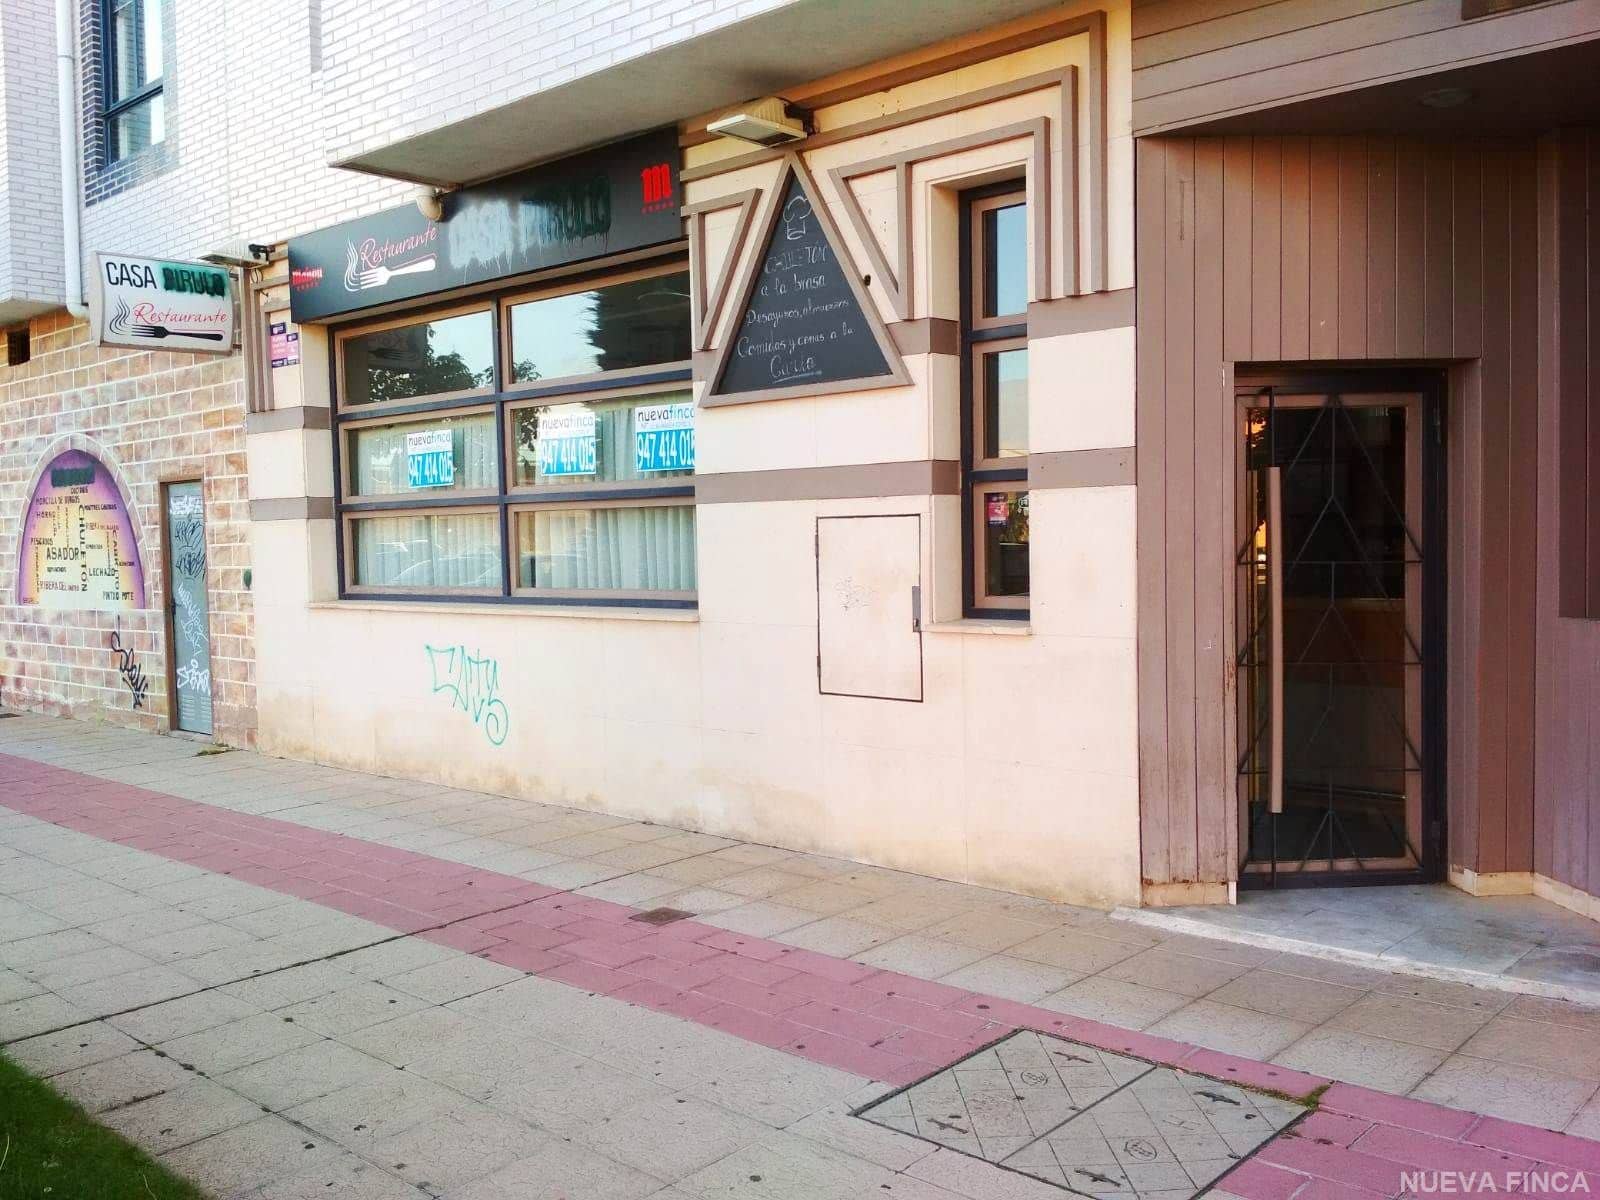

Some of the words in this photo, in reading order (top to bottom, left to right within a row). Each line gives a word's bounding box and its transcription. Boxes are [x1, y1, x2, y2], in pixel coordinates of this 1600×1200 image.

[360, 220, 438, 270] Restaurante
[106, 262, 157, 289] CASA
[775, 277, 787, 295] la
[793, 273, 826, 291] brasa
[133, 302, 228, 325] Restaurante
[738, 331, 786, 358] Comidas
[797, 334, 825, 346] cenas
[542, 440, 559, 473] 947
[561, 438, 577, 472] 414
[579, 437, 595, 471] 015
[638, 433, 656, 470] 947
[659, 432, 677, 467] 414
[408, 455, 423, 487] 947
[46, 547, 79, 561] ASADOR
[88, 568, 115, 576] LECHAZO
